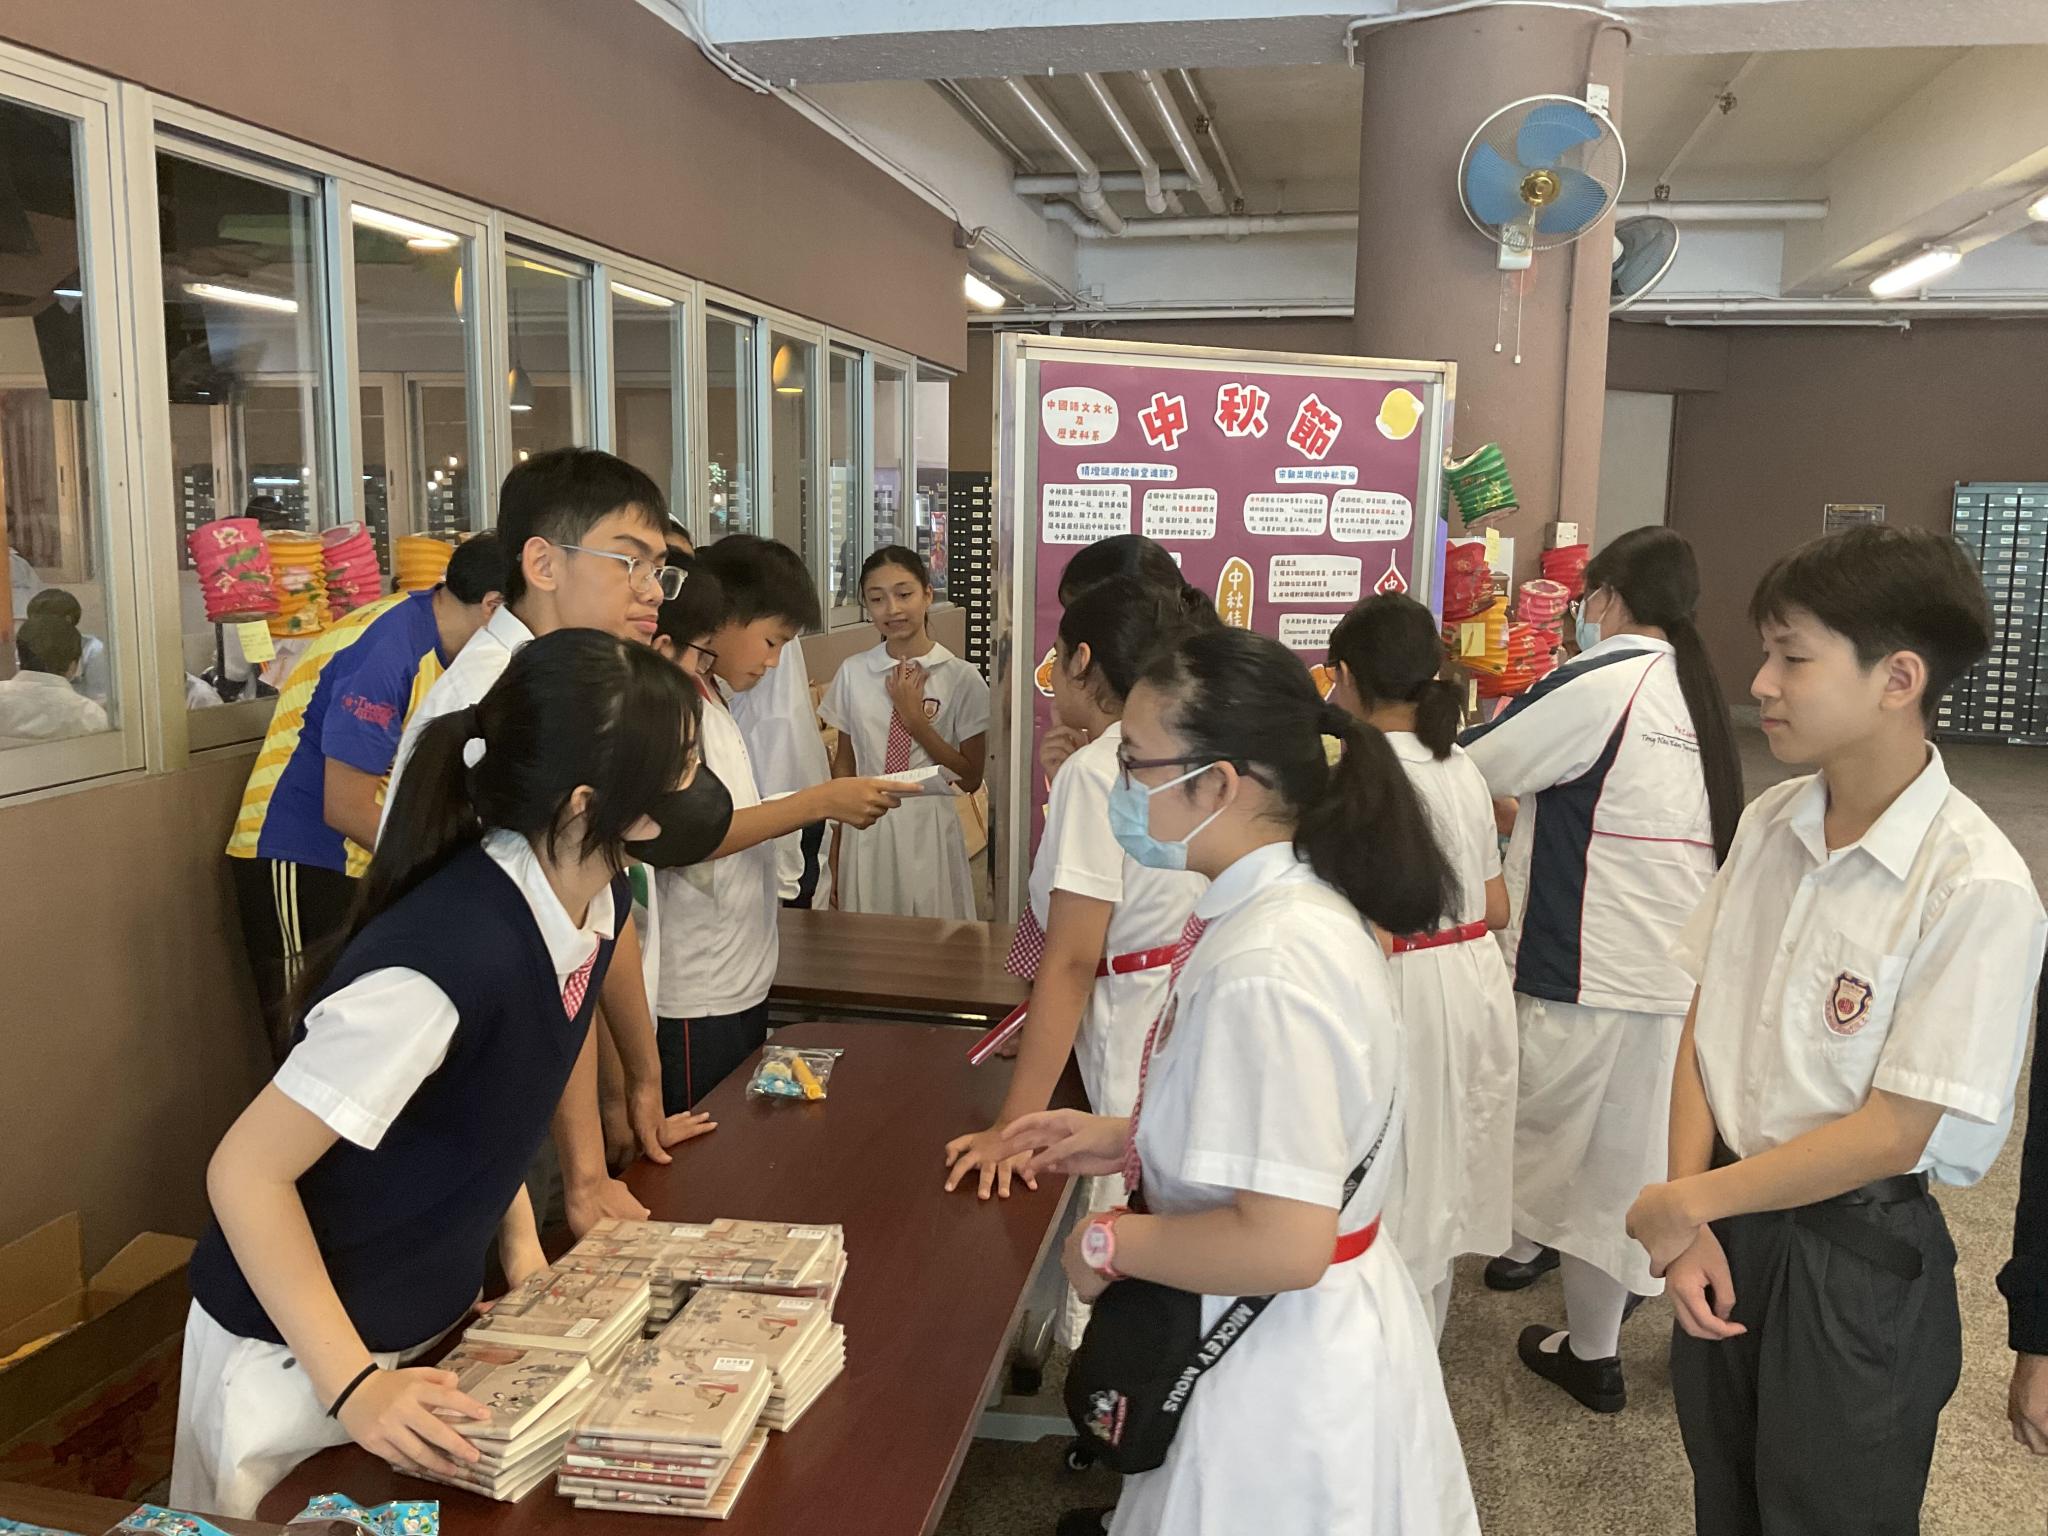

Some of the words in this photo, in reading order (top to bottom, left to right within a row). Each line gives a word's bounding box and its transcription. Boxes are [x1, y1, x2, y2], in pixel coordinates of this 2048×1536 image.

[1226, 568, 1243, 627] 中秋佳
[1384, 576, 1399, 591] 中
[1197, 1303, 1254, 1366] MICKEY
